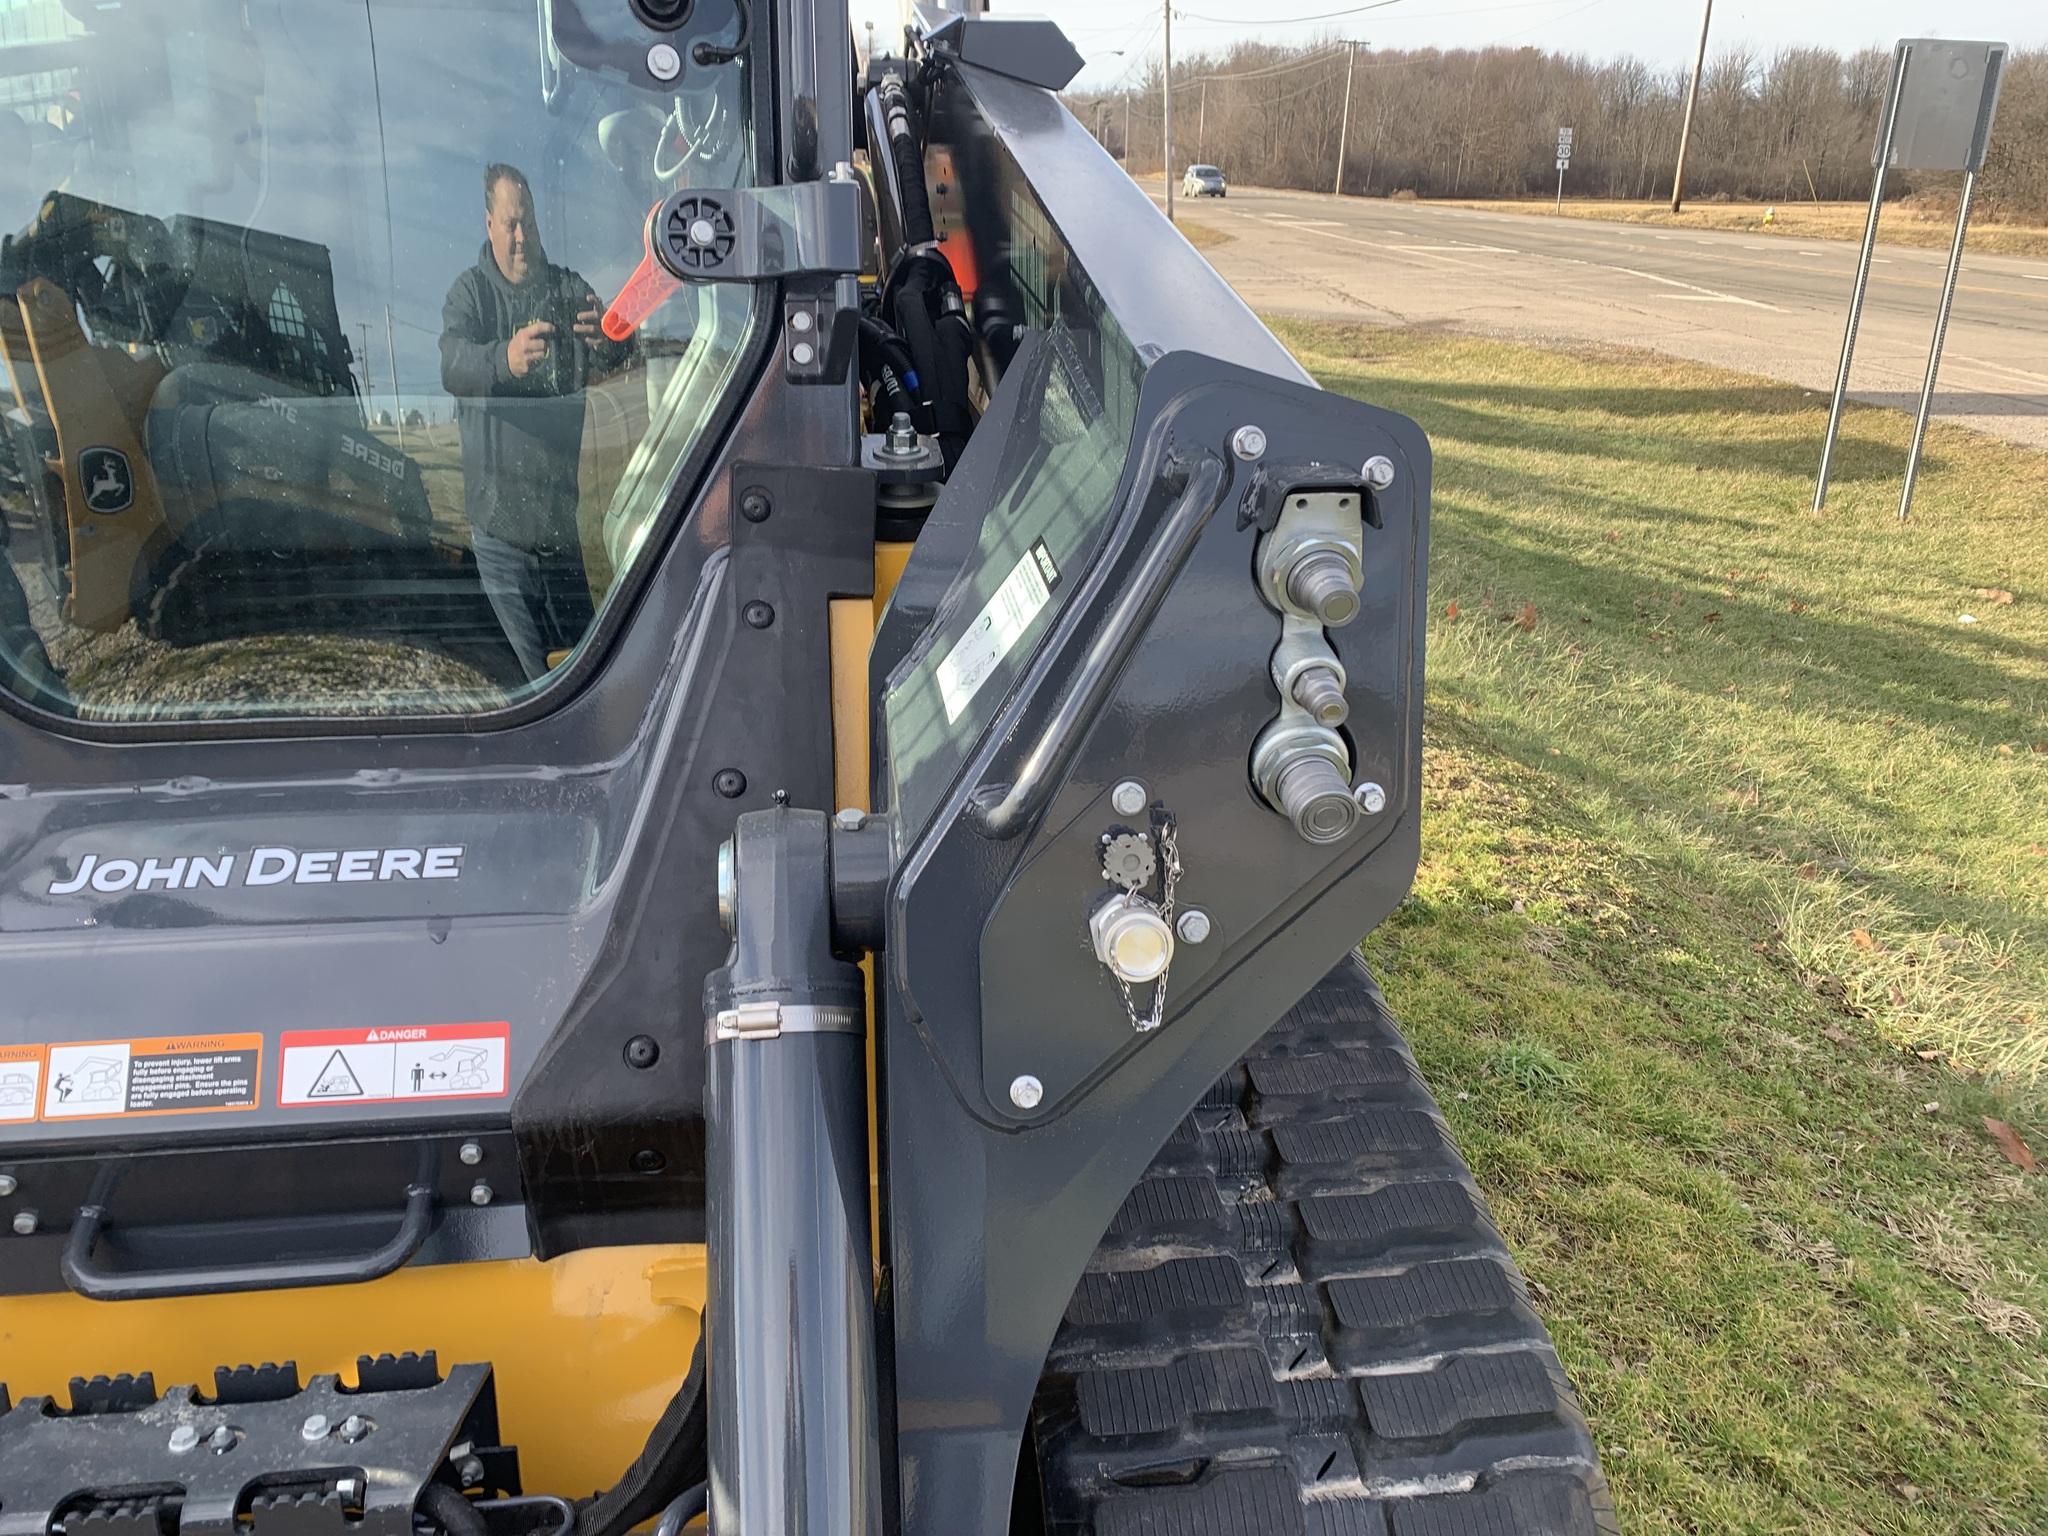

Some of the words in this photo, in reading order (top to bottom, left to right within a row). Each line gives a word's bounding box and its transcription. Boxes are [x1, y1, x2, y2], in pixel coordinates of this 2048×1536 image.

[1559, 147, 1570, 156] 30
[49, 854, 235, 895] JOHN
[244, 846, 464, 887] DEERE
[380, 1028, 427, 1041] DANGER
[176, 1040, 225, 1050] WARNING
[0, 1050, 37, 1059] RNING
[134, 1060, 143, 1068] To
[143, 1059, 170, 1069] prevent
[170, 1058, 192, 1067] injury,
[193, 1057, 212, 1065] lower
[213, 1056, 223, 1064] lift
[224, 1056, 241, 1064] arms
[132, 1068, 148, 1076] fully
[172, 1066, 205, 1074] engaging
[132, 1076, 175, 1084] disengaging
[175, 1073, 214, 1081] attachment
[131, 1084, 174, 1093] engagement
[174, 1082, 191, 1090] pins.
[195, 1080, 219, 1089] Ensure
[220, 1079, 232, 1087] the
[232, 1078, 248, 1087] pins
[143, 1091, 158, 1100] fully
[159, 1089, 190, 1099] engaged
[190, 1088, 213, 1097] before
[213, 1087, 247, 1096] operating
[129, 1099, 153, 1108] loader.
